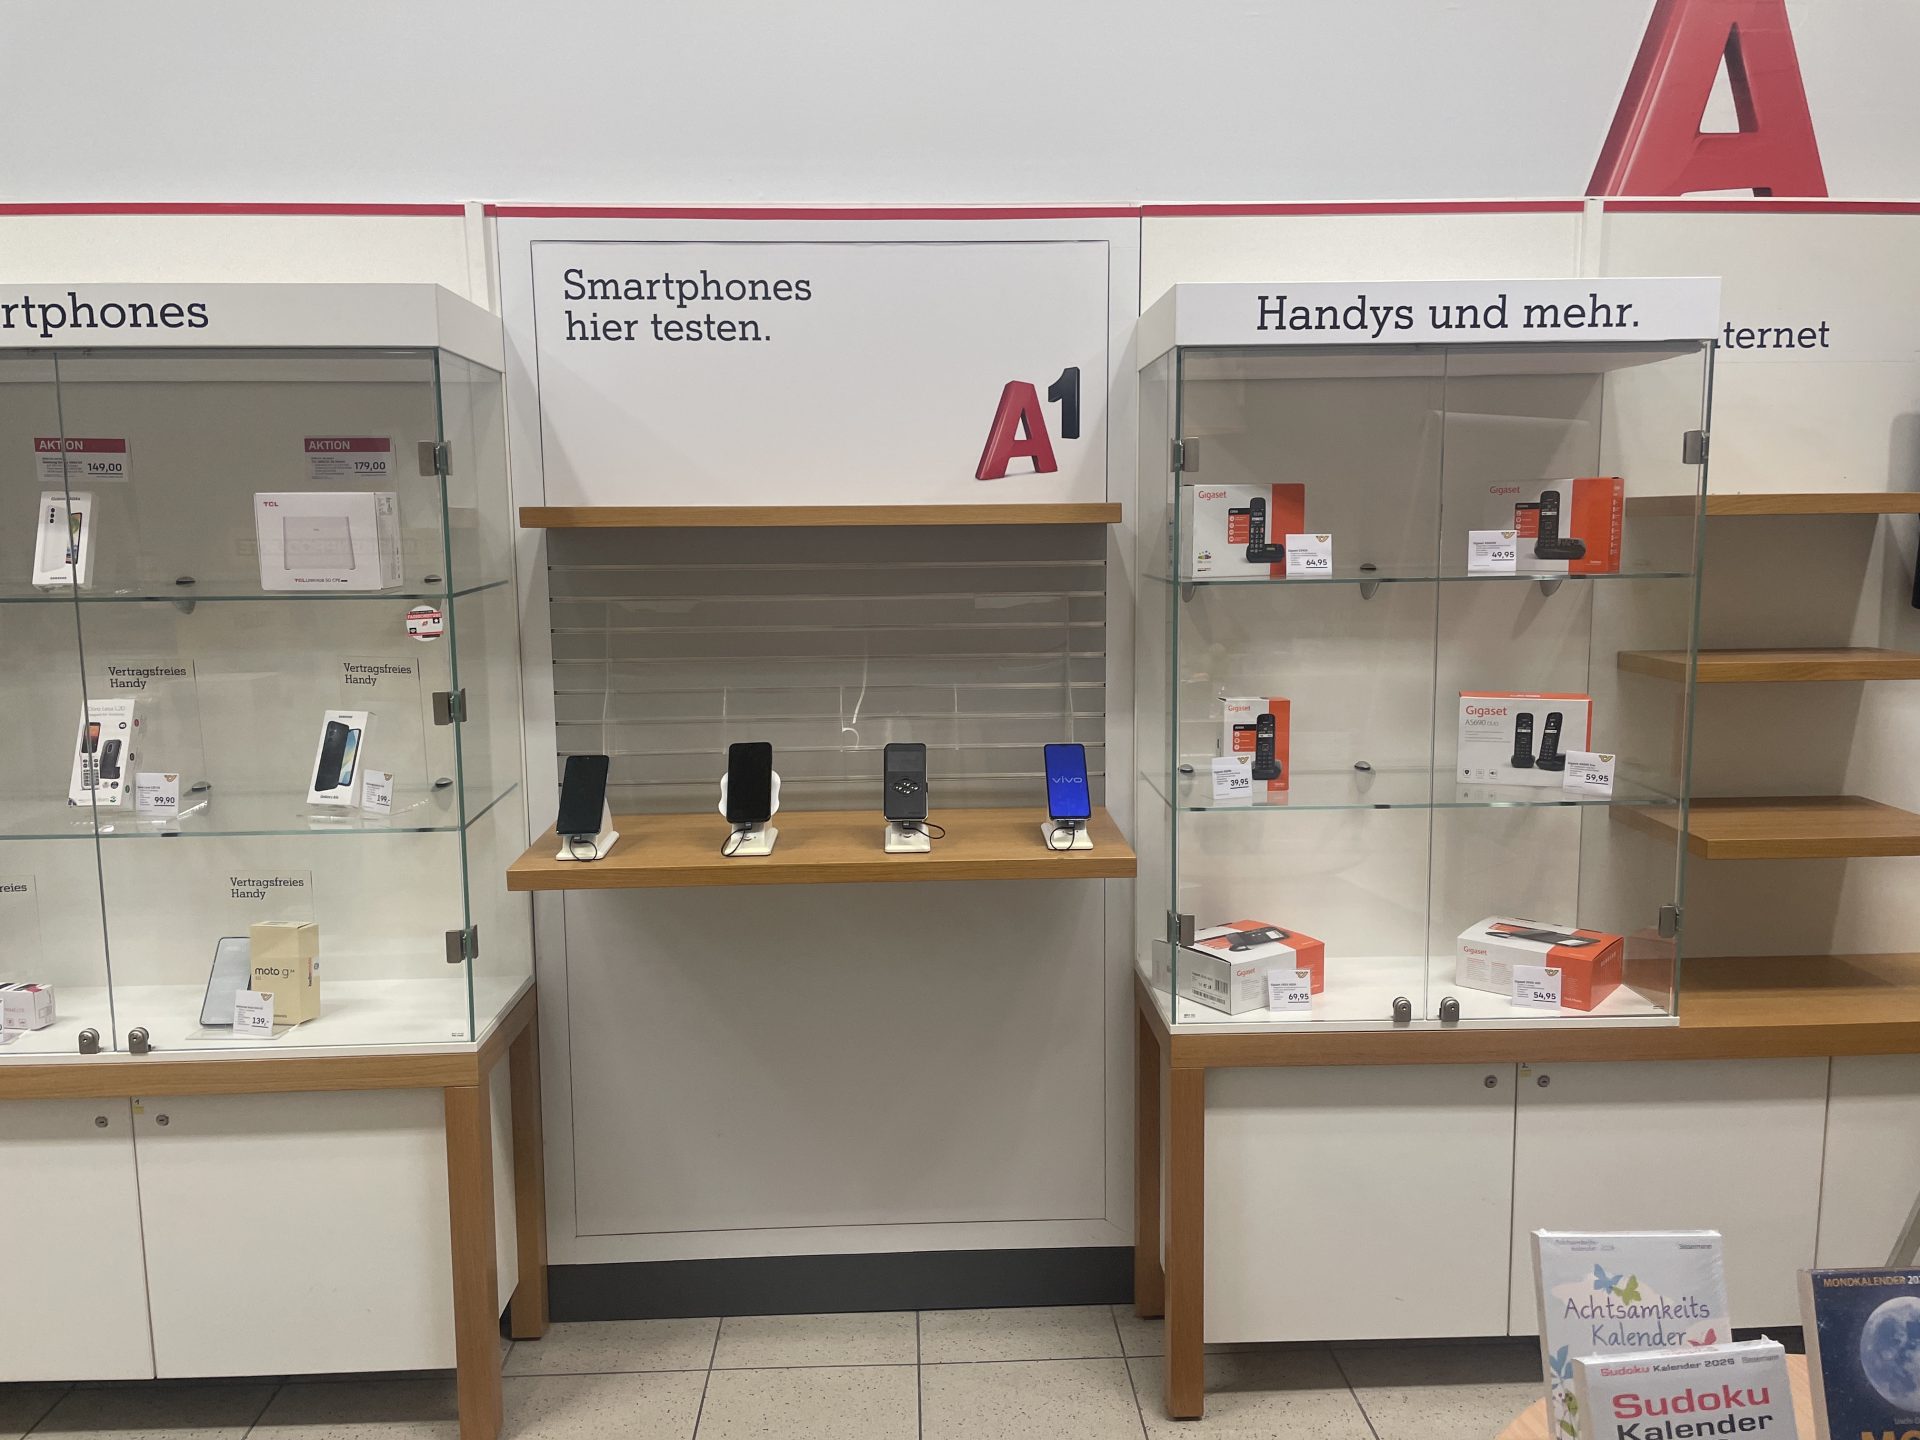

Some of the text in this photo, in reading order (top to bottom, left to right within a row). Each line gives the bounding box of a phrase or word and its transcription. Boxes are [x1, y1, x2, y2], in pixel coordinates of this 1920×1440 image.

[564, 268, 812, 309] Smartphones
[1, 292, 209, 338] rtphones
[1256, 293, 1640, 339] Handys und mehr.
[565, 310, 771, 342] hier testen.
[1714, 320, 1830, 349] ternet
[975, 366, 1081, 481] A1
[39, 440, 84, 450] AKTON
[308, 440, 351, 450] AKTION
[87, 463, 122, 473] 149,00
[354, 461, 386, 471] 179,00
[1198, 490, 1227, 500] Gigaset
[1489, 486, 1521, 496] Gigaset
[1491, 551, 1515, 559] 49,95
[1306, 559, 1328, 567] 64,95
[108, 666, 187, 678] Vertragsfreies
[343, 663, 412, 675] Vertragsfreies
[110, 678, 147, 690] Handy
[345, 674, 377, 686] Handy
[1465, 705, 1508, 718] Gigaset
[1052, 776, 1083, 784] vivo
[1230, 778, 1249, 786] 39,95
[1585, 773, 1609, 783] 59,95
[154, 796, 175, 805] 99,90
[230, 877, 304, 889] Vertragsfreies
[231, 889, 266, 900] Handy
[1463, 945, 1488, 956] Gigaset
[254, 967, 280, 976] moto
[282, 968, 289, 979] g
[1288, 993, 1309, 1002] 69,95
[1533, 991, 1557, 1000] 54,95
[1823, 1275, 1906, 1288] MONDKALENDER
[1564, 1294, 1711, 1320] Achtsamkeits
[1591, 1320, 1688, 1347] Kalender
[1600, 1366, 1650, 1377] Sudoku
[1652, 1361, 1702, 1373] Kalender
[1704, 1358, 1735, 1368] 2026
[1611, 1384, 1771, 1420] Sudoku
[1615, 1412, 1774, 1440] Kalender
